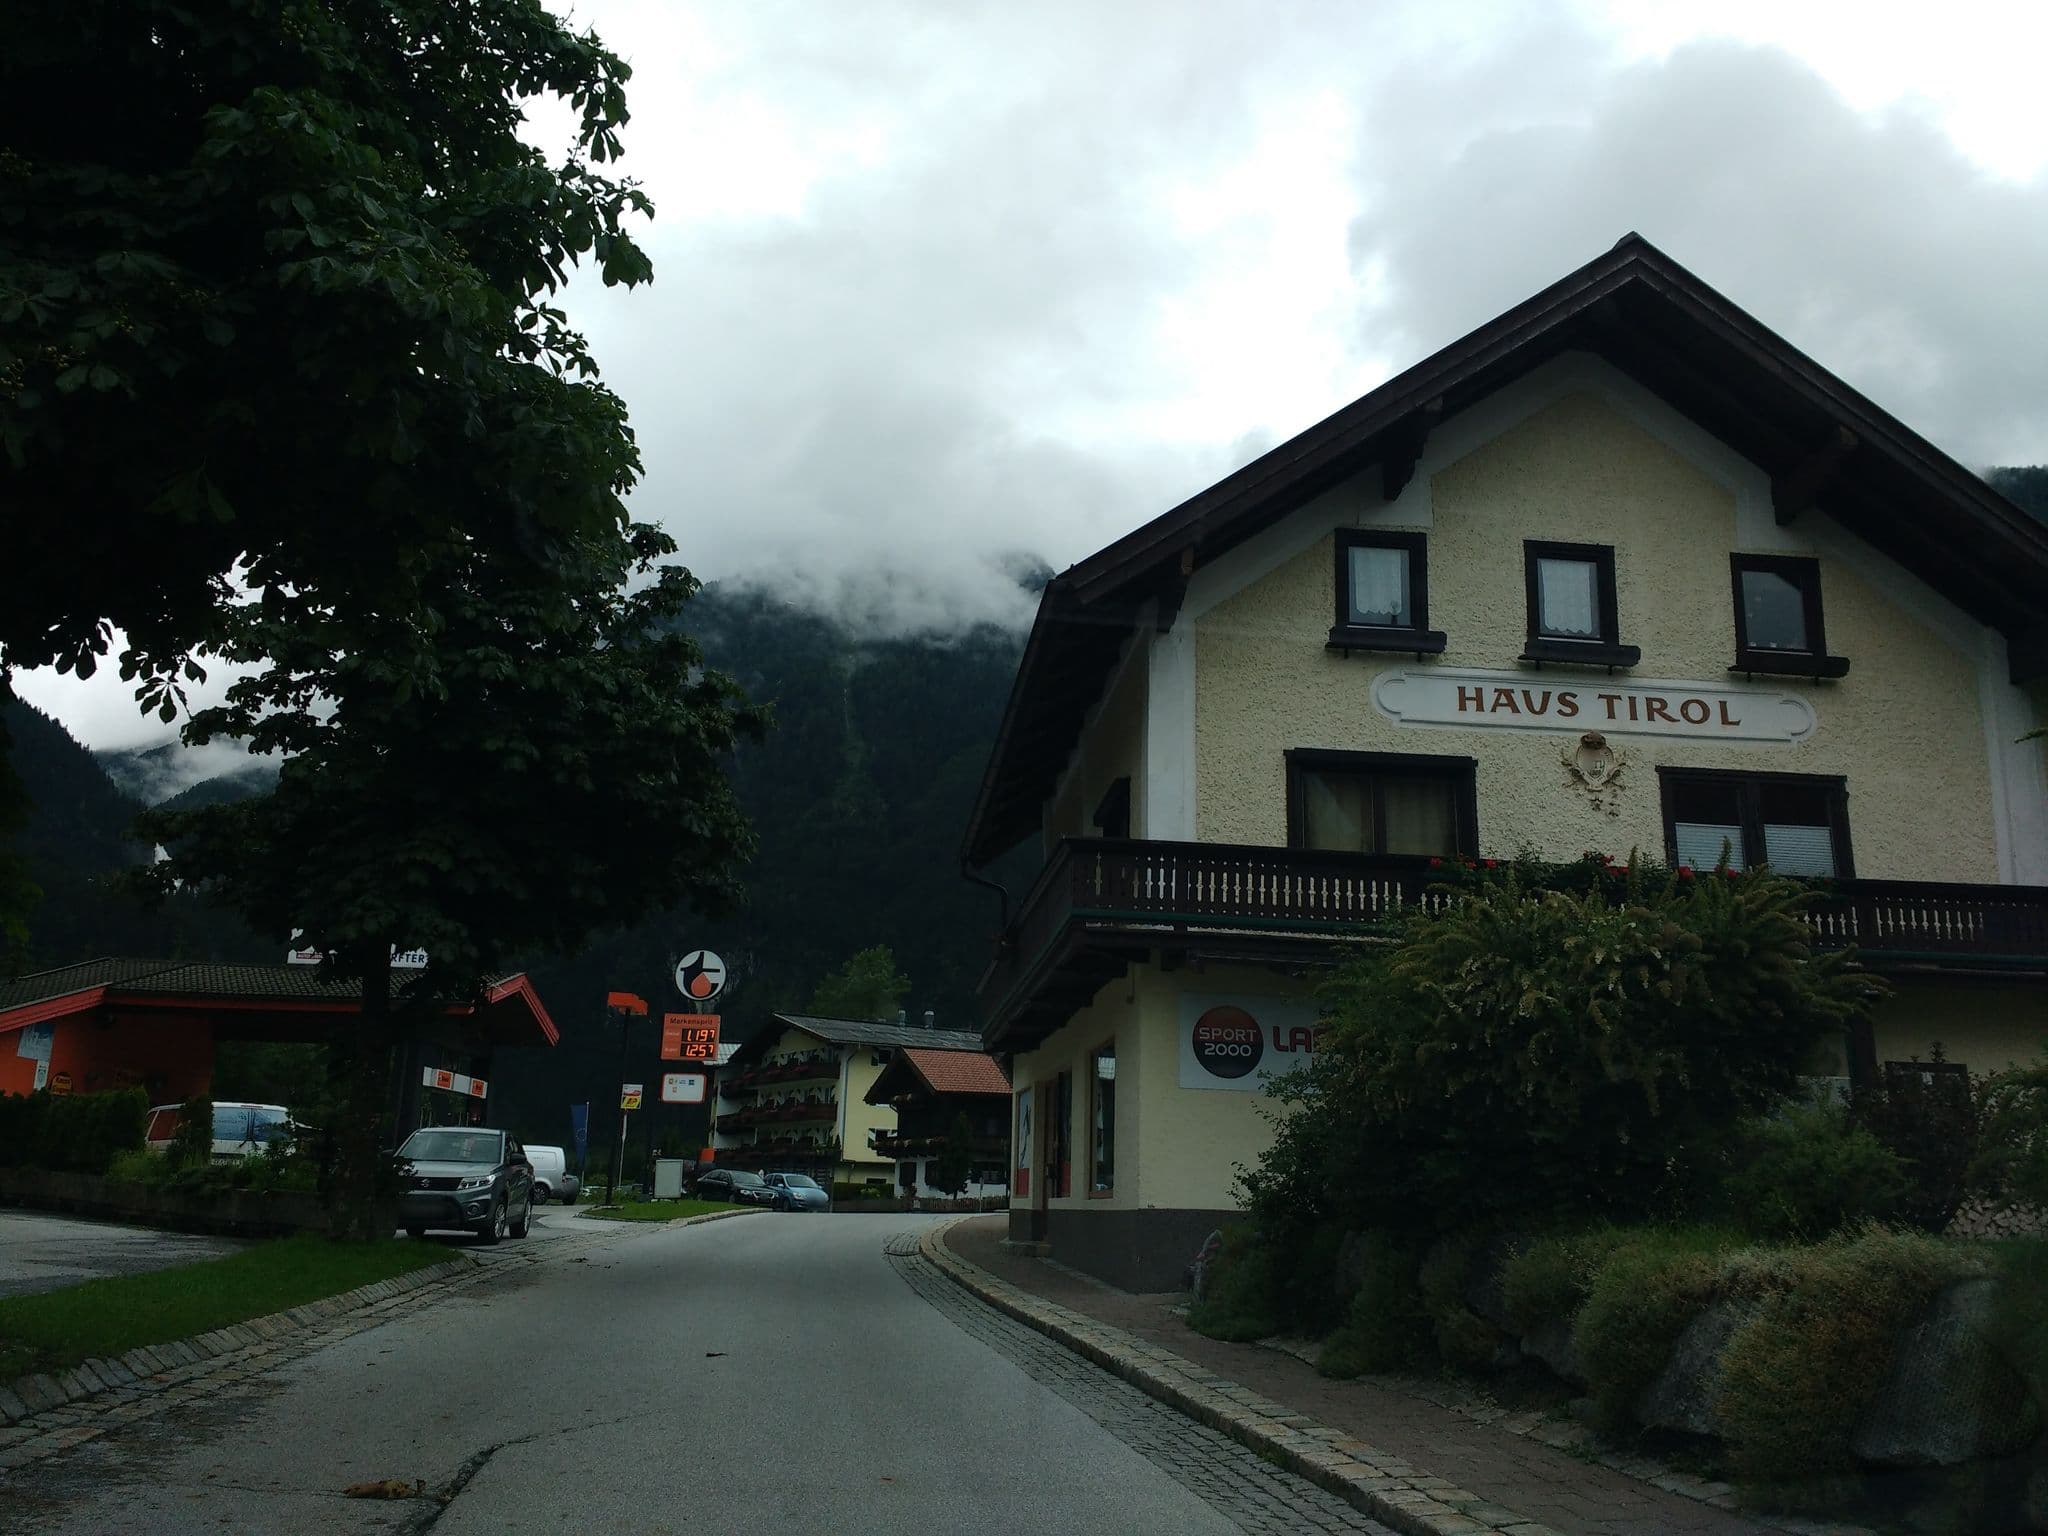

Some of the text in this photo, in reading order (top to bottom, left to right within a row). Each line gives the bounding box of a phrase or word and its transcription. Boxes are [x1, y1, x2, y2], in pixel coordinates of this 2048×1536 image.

[1457, 686, 1741, 725] HAUS TIROL
[1199, 1027, 1257, 1042] SPORT
[1204, 1042, 1253, 1057] 2000
